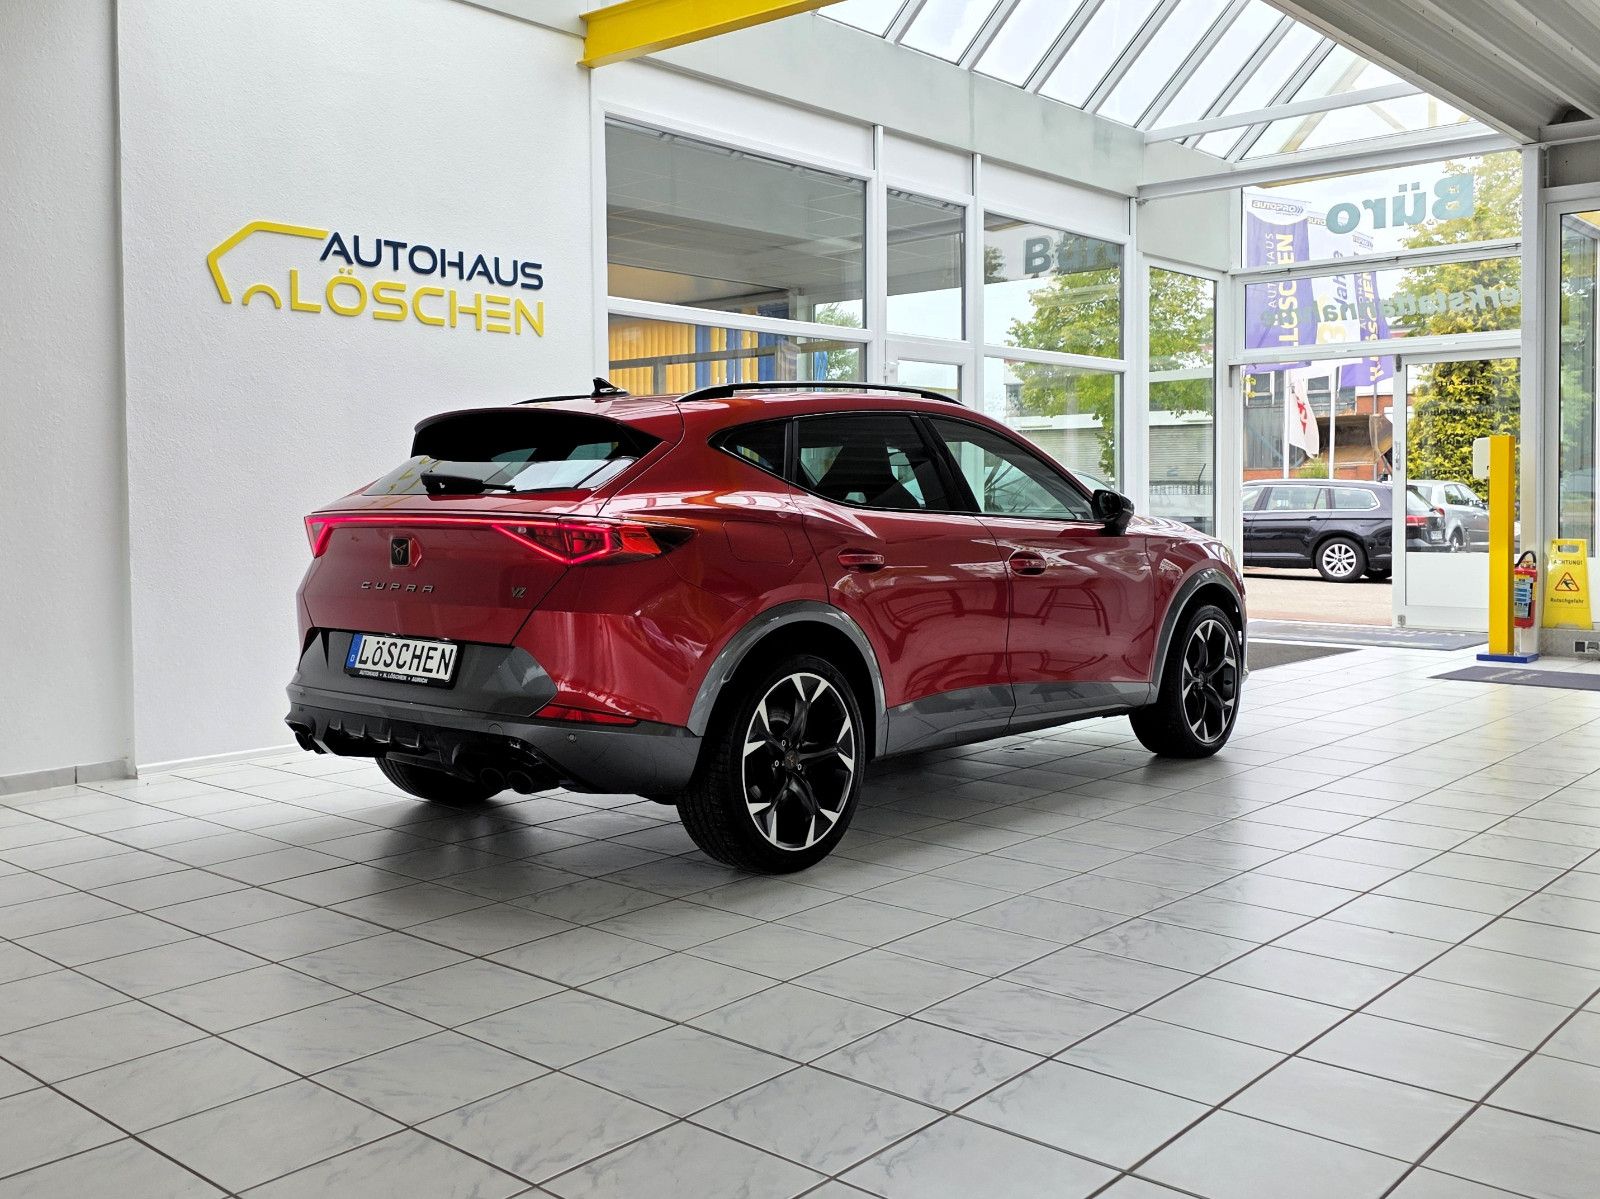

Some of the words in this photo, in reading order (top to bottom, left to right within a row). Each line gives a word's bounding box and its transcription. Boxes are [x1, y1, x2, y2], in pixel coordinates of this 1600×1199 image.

[319, 231, 544, 290] AUTOHAUS
[1264, 232, 1277, 308] AUTHAUS
[1274, 234, 1299, 343] LÖSCEN
[1332, 250, 1348, 305] Jahe
[290, 267, 545, 337] LÖSCHEN
[361, 581, 435, 594] CUPRA
[357, 639, 454, 676] LÖSCHEN
